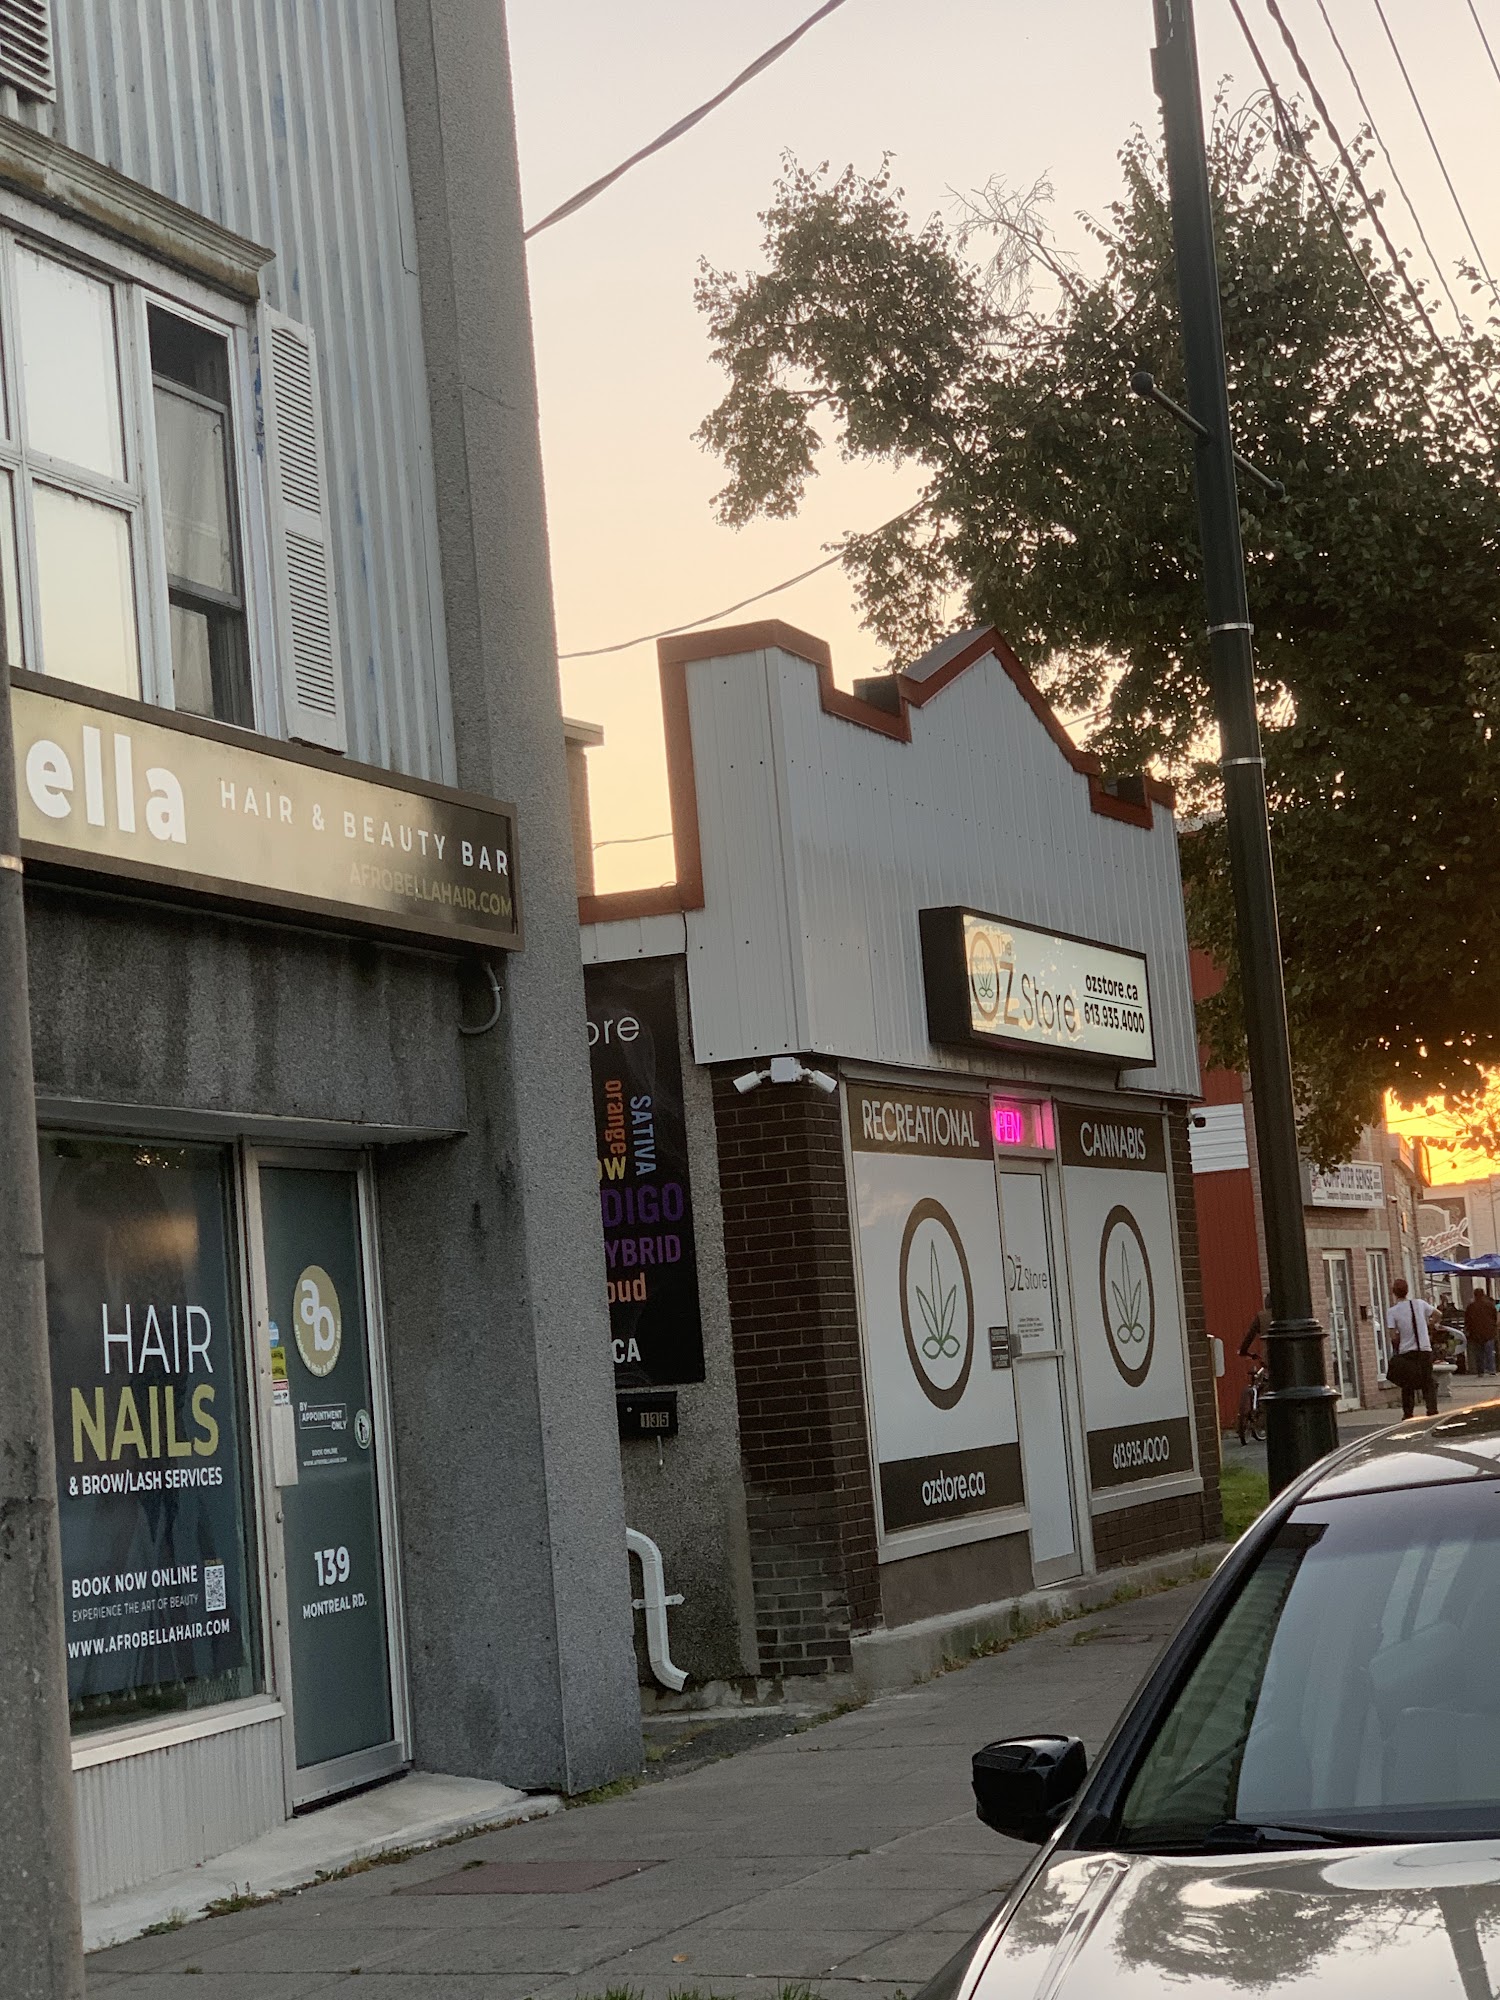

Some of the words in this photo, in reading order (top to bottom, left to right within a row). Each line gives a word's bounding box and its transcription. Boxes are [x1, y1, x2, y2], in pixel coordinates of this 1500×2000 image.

[25, 725, 187, 844] ella
[221, 779, 293, 825] HAIR
[312, 804, 325, 831] &
[344, 810, 446, 860] BEAUTY
[462, 840, 508, 876] BAR
[350, 861, 513, 918] AFROBELLAHAIR.COM
[1021, 973, 1077, 1034] Store
[1085, 973, 1139, 1001] ozstore.ca
[1084, 1001, 1145, 1034] 613.935.4000
[604, 1079, 627, 1155] orange
[630, 1095, 657, 1176] SATIVA
[862, 1099, 980, 1148] RECREATIONAL
[1080, 1121, 1147, 1160] CANNABIS
[601, 1182, 684, 1227] DIGO
[605, 1234, 681, 1268] YBRID
[1024, 1268, 1048, 1291] Store
[299, 1278, 336, 1351] ab
[101, 1302, 213, 1375] HAIR
[611, 1337, 641, 1364] CA
[70, 1384, 220, 1463] NAILS
[299, 1401, 308, 1412] BY
[301, 1409, 343, 1422] APPOINTMENT
[640, 1411, 669, 1429] 135
[1113, 1434, 1170, 1471] 613.935.4000
[69, 1476, 79, 1496] &
[82, 1469, 162, 1496] BROW/LASH
[164, 1466, 223, 1489] SERVICES
[921, 1469, 986, 1507] ozstore.ca
[71, 1575, 112, 1599] BOOK
[115, 1570, 148, 1593] NOW
[151, 1564, 199, 1587] ONLINE
[313, 1546, 351, 1587] 139
[71, 1604, 122, 1623] EXPERIENCE
[124, 1601, 140, 1616] THE
[141, 1599, 157, 1613] ART
[157, 1598, 169, 1611] OF
[169, 1594, 199, 1608] BEAUTY
[302, 1596, 351, 1619] MONTREAL
[352, 1592, 367, 1608] RD.
[67, 1617, 231, 1660] WWW.AFROBELLAHAIR.COM
